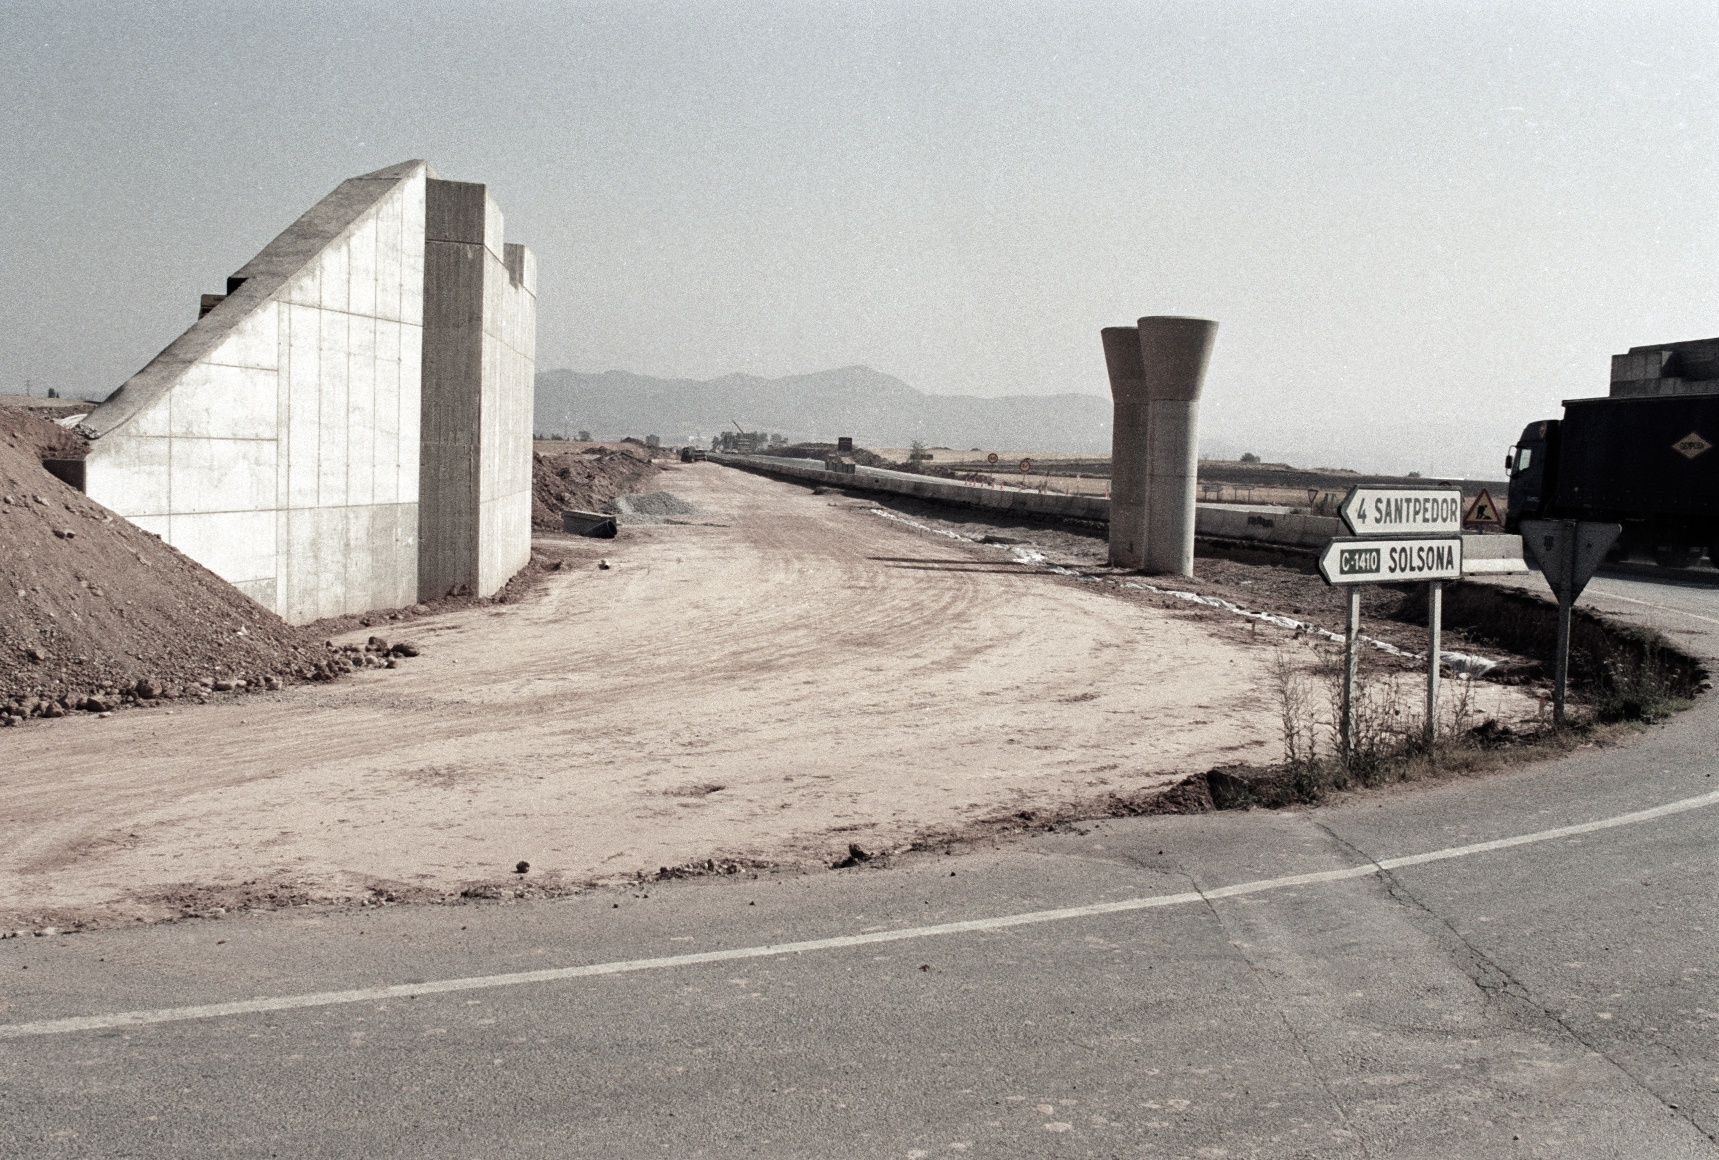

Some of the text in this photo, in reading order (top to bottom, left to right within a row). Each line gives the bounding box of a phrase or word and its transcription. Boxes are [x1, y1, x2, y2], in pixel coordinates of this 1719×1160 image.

[1357, 497, 1458, 524] 4 SANTPEDOR
[1341, 545, 1454, 573] C-1410 SOLSONA
